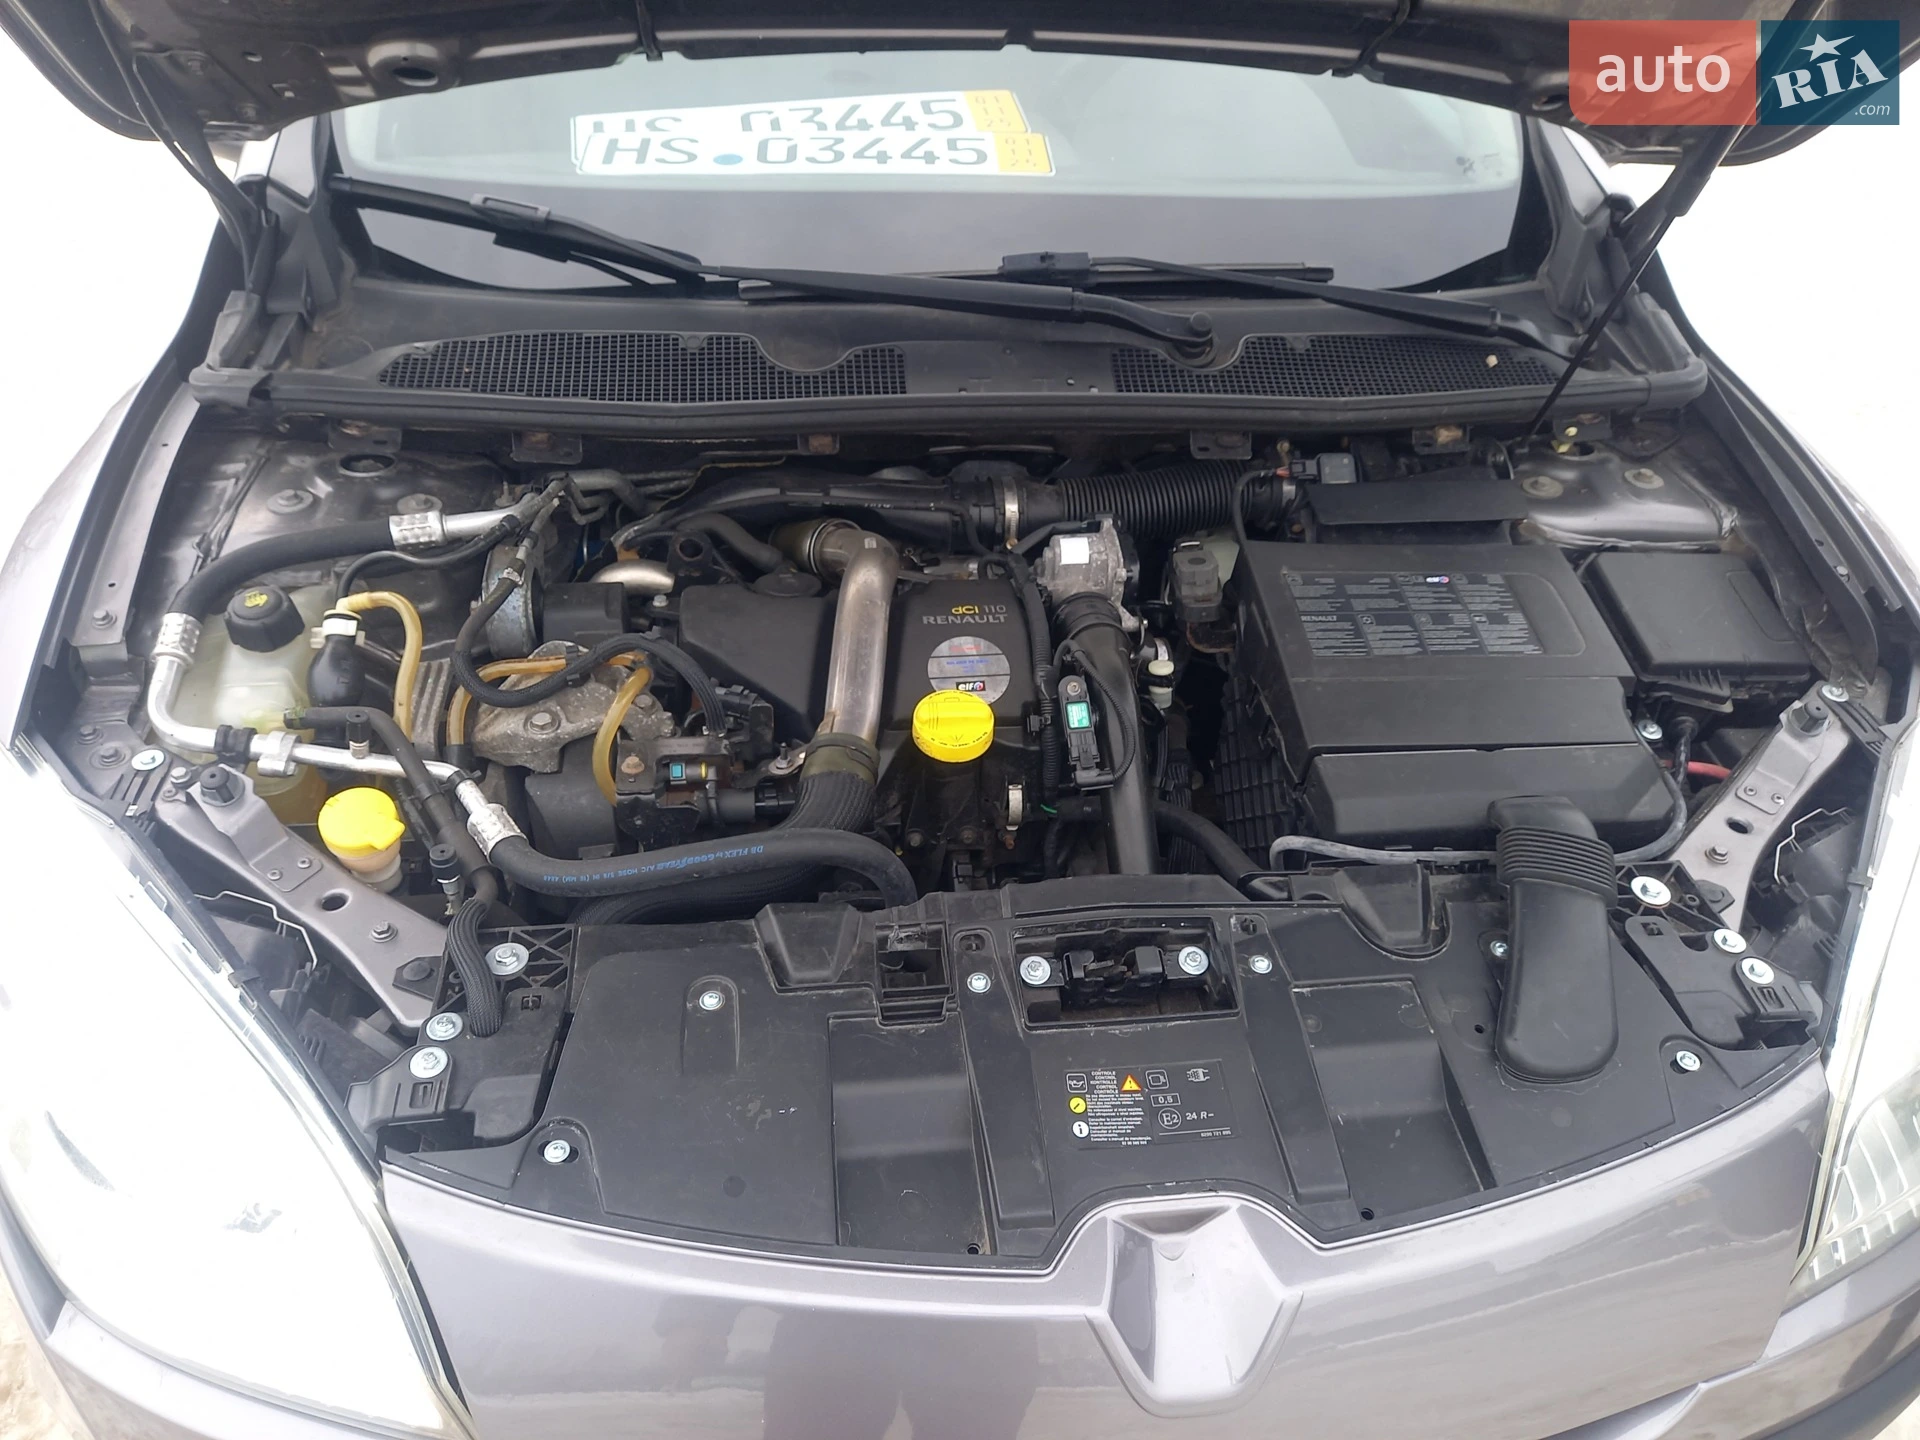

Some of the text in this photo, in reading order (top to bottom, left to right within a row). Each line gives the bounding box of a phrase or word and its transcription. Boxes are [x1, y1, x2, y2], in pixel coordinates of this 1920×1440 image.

[602, 137, 988, 165] HS 03445
[984, 604, 1006, 614] 110
[922, 614, 1008, 624] RENAULT
[958, 682, 974, 691] elf
[724, 848, 748, 858] FLEX
[618, 868, 638, 876] HOSE
[1158, 1096, 1173, 1104] 0,5
[1162, 1112, 1179, 1125] E2
[1185, 1112, 1198, 1120] 24
